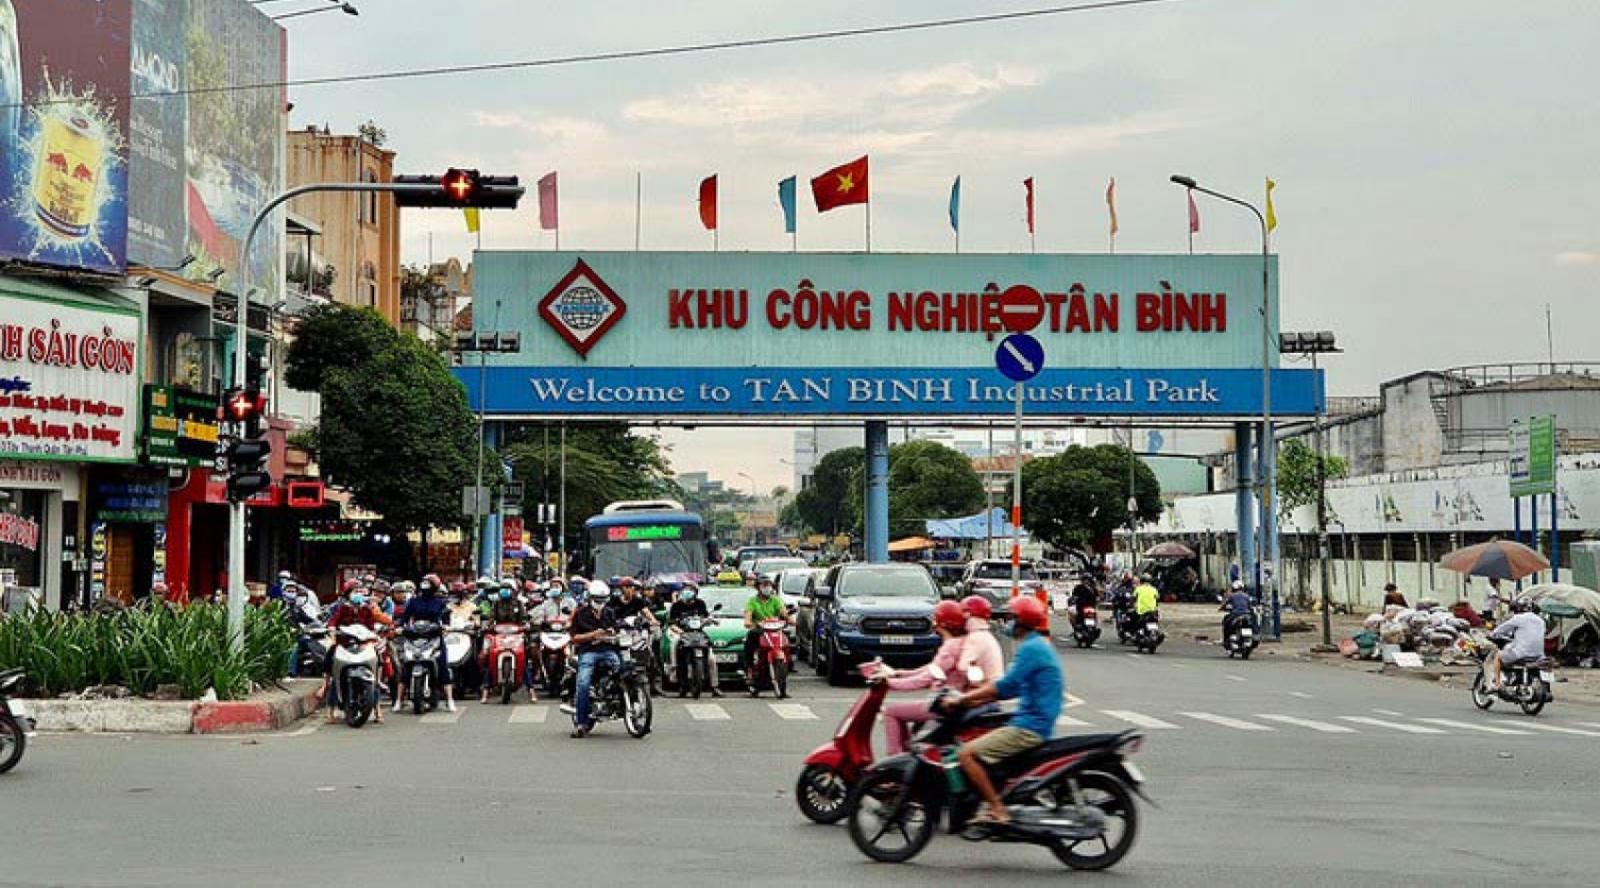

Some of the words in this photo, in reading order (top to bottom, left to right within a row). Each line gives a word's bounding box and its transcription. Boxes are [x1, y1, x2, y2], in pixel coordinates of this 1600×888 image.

[669, 289, 749, 328] KHU
[766, 279, 871, 331] CÔNG
[888, 283, 1012, 341] NGHIỆ
[1044, 283, 1119, 332] TÂN
[1136, 281, 1226, 331] BÌNH
[530, 378, 684, 402] Welcome
[699, 383, 731, 402] to
[744, 378, 832, 401] TAN
[848, 378, 953, 402] BINH
[1146, 378, 1220, 402] Park
